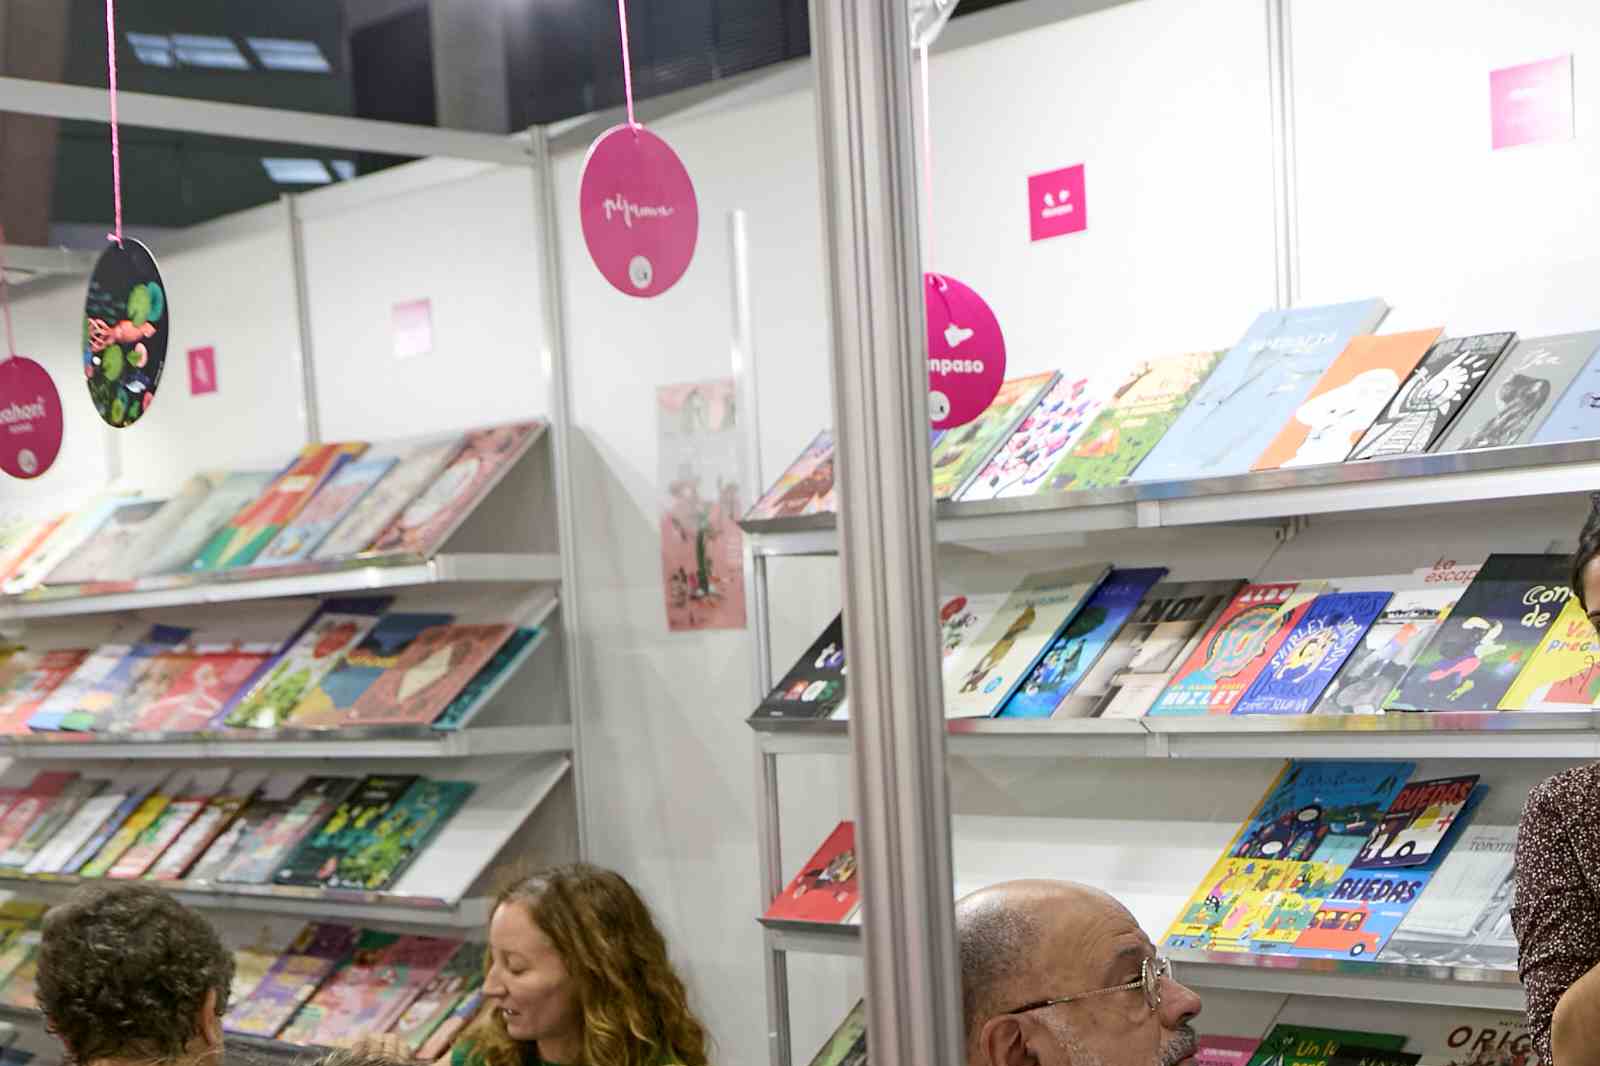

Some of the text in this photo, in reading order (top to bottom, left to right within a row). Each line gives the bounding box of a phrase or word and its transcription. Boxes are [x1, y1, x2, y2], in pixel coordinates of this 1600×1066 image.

[928, 357, 985, 377] npaso
[1424, 567, 1480, 585] escap
[1520, 605, 1551, 629] de
[1390, 780, 1474, 812] RUEDAS
[1330, 878, 1423, 905] RUEDAS
[1446, 1024, 1534, 1057] ORIG
